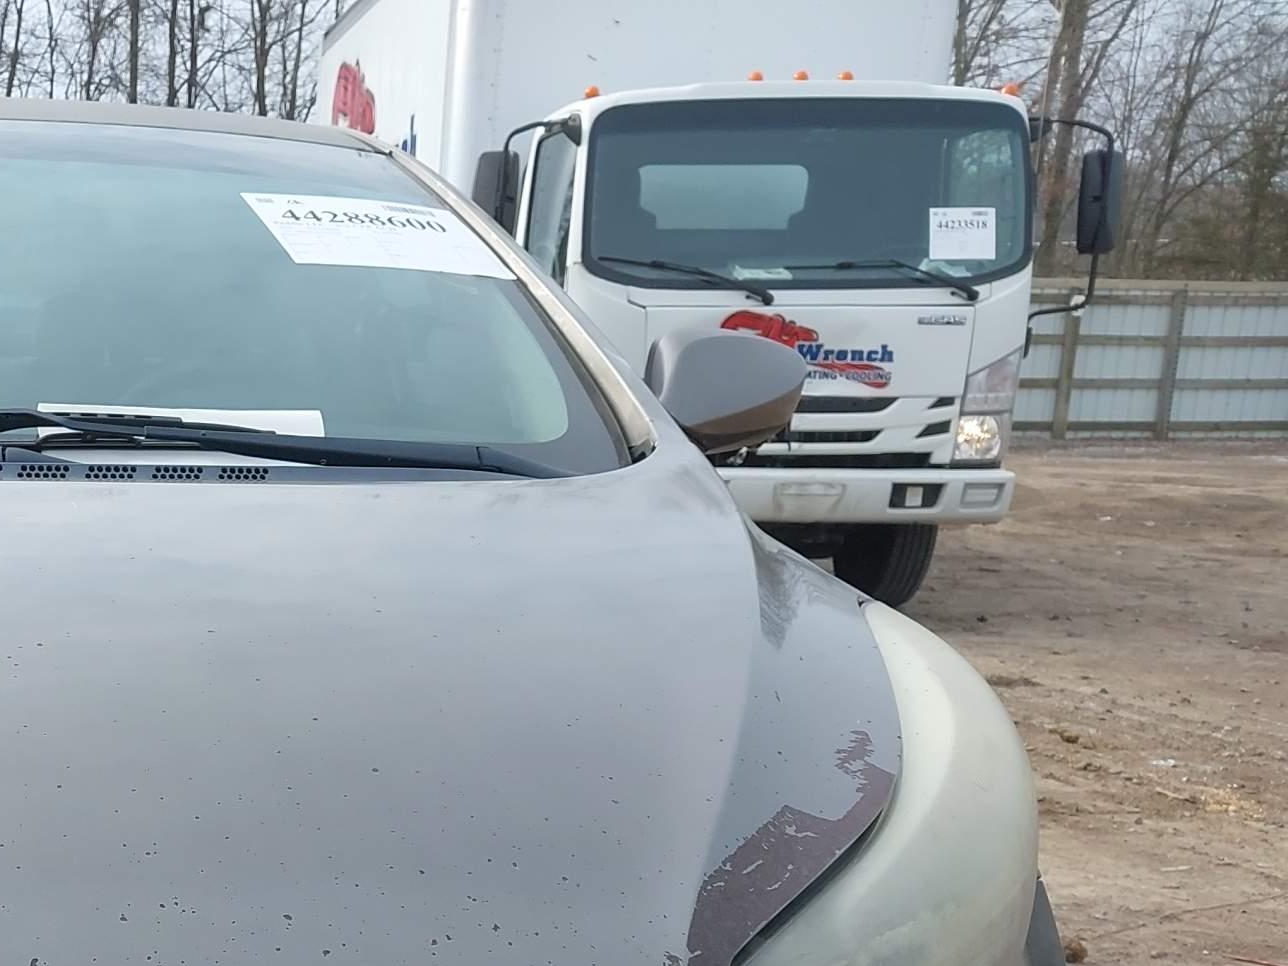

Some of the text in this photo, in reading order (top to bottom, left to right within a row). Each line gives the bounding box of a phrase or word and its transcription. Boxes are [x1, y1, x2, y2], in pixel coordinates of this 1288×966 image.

[281, 208, 448, 233] 44288600
[936, 219, 989, 230] 44233518
[797, 343, 894, 363] Wrench
